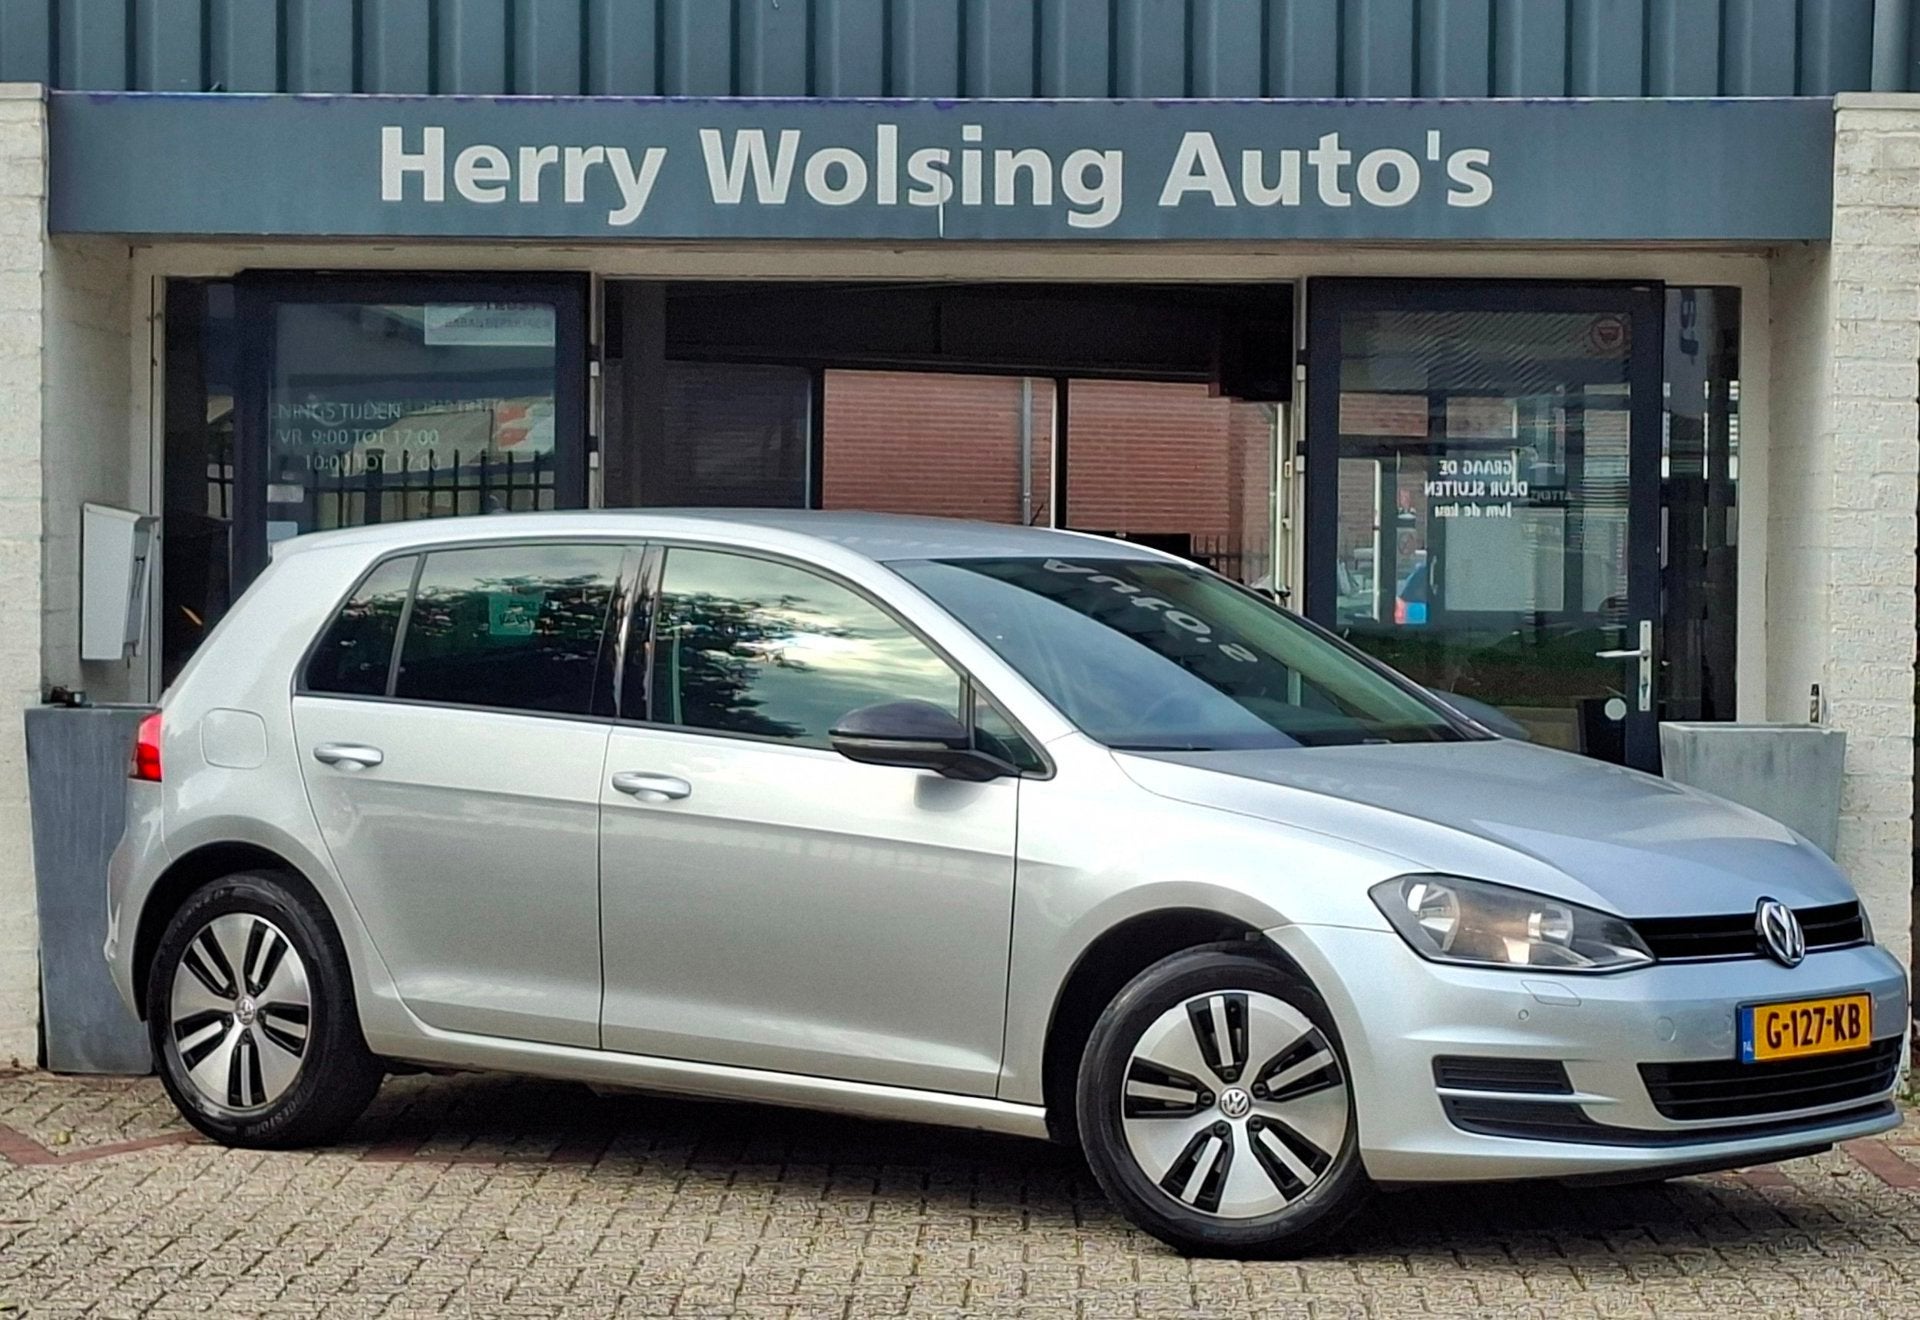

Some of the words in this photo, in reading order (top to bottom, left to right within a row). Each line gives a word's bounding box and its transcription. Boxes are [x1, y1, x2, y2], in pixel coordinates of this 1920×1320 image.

[379, 126, 667, 226] Herry
[699, 124, 1125, 230] Wolsing
[1158, 130, 1494, 207] Auto's
[353, 428, 385, 445] TOT
[1766, 1003, 1861, 1049] G-127-KB
